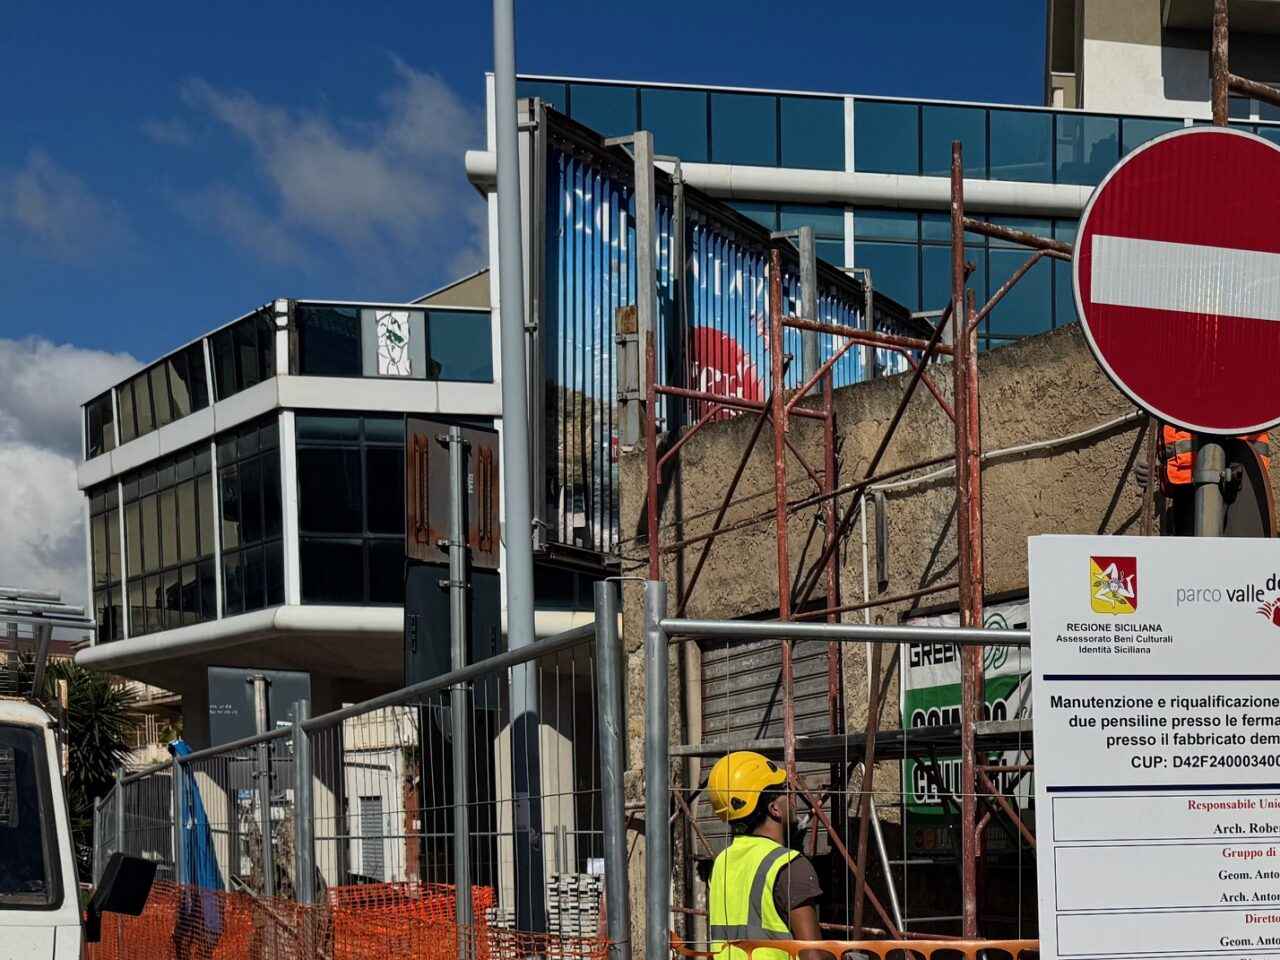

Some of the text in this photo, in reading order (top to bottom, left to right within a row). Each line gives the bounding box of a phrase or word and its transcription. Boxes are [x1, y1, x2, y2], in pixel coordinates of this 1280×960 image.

[1176, 587, 1222, 606] parco
[1226, 584, 1265, 603] valle
[1065, 622, 1163, 632] REGIONE SICILIANA
[1055, 633, 1173, 643] Assessorato Beni Culturali
[1078, 645, 1151, 654] Identità Siciliana
[1050, 694, 1153, 709] Manutenzione
[1170, 694, 1280, 711] riqualificazione
[1068, 714, 1096, 728] due
[1100, 713, 1167, 730] pensiline
[1171, 716, 1221, 730] presso
[1225, 713, 1238, 726] le
[1105, 735, 1156, 749] presso
[1160, 732, 1168, 745] il
[1172, 731, 1246, 746] fabbricato
[1130, 755, 1167, 769] CUP:
[1187, 798, 1256, 812] Responsabile
[1212, 822, 1246, 834] Arch.
[1221, 847, 1263, 860] Gruppo
[1265, 846, 1276, 856] di
[1217, 869, 1252, 880] Geom.
[1219, 891, 1249, 902] Arch.
[1219, 936, 1253, 947] Geom.
